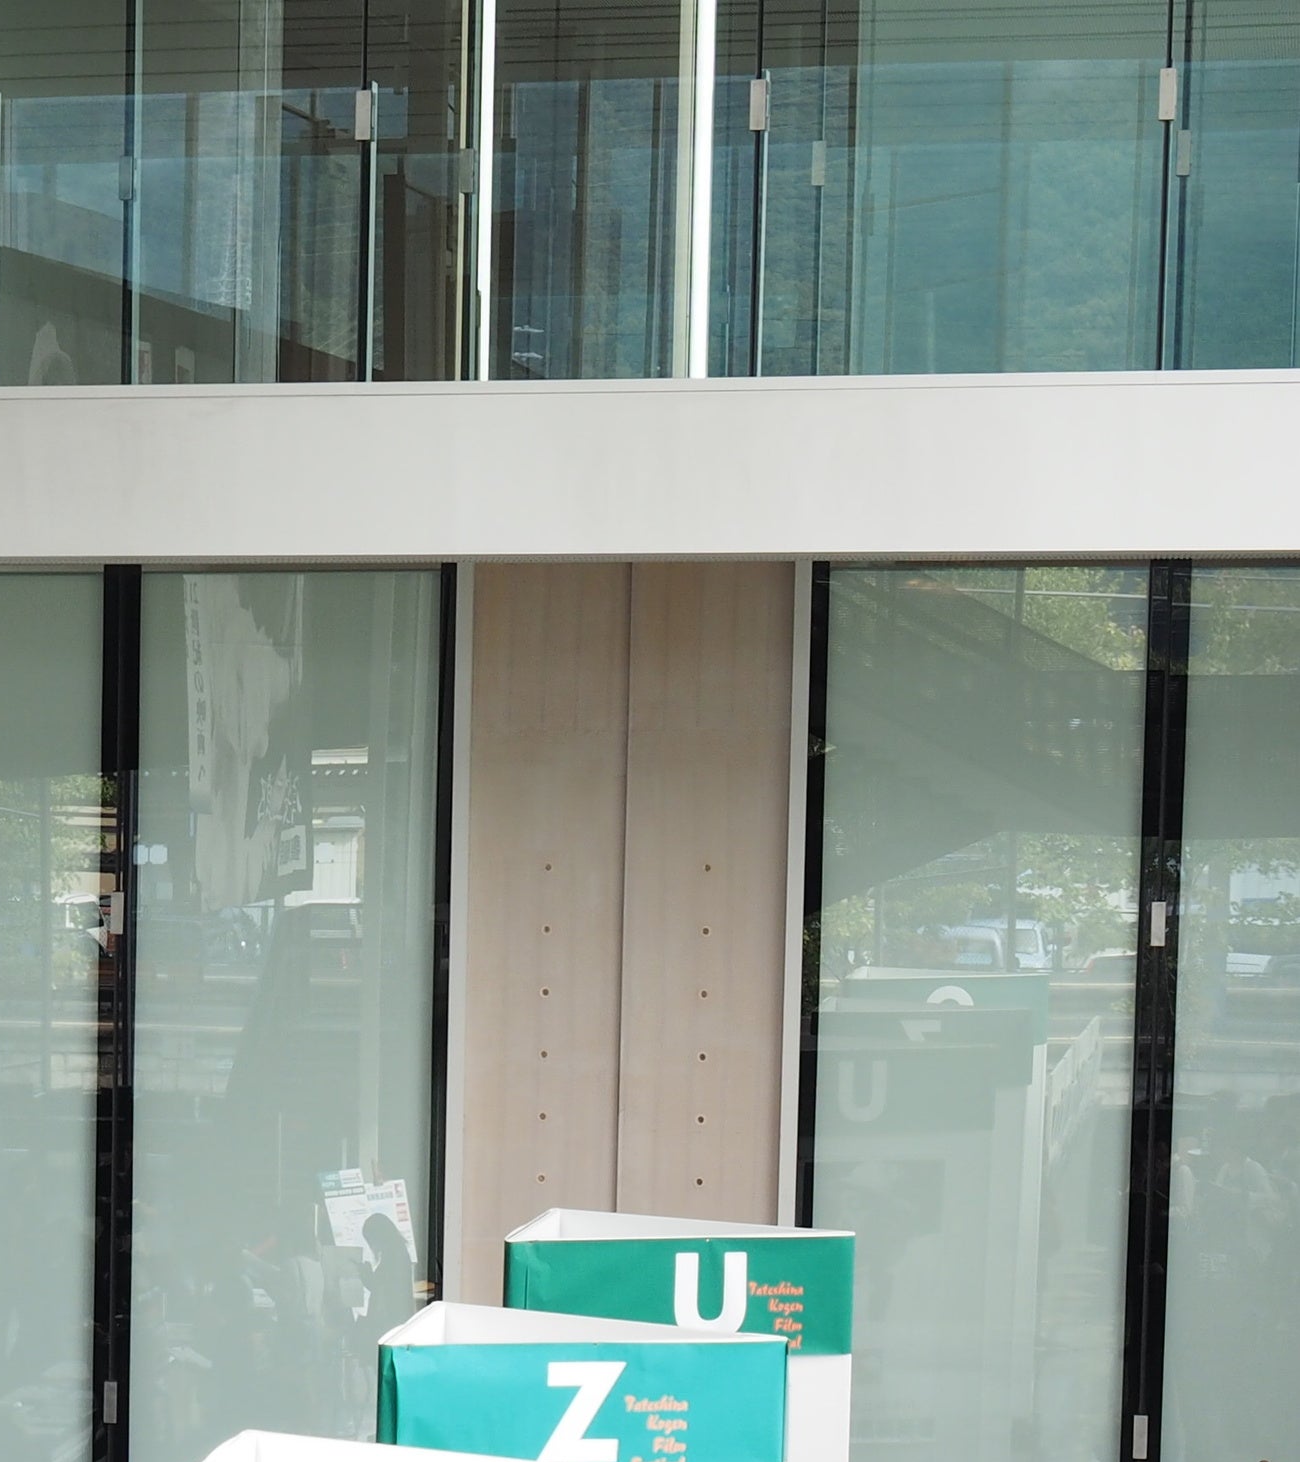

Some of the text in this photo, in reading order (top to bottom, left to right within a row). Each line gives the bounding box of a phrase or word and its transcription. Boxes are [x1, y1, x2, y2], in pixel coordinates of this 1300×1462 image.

[674, 1252, 747, 1334] U
[749, 1281, 804, 1295] Tateshina
[768, 1299, 803, 1315] Kogen
[775, 1318, 802, 1332] Film
[625, 1395, 688, 1412] Tateshina
[647, 1414, 688, 1434] Kogen
[653, 1437, 686, 1453] Film
